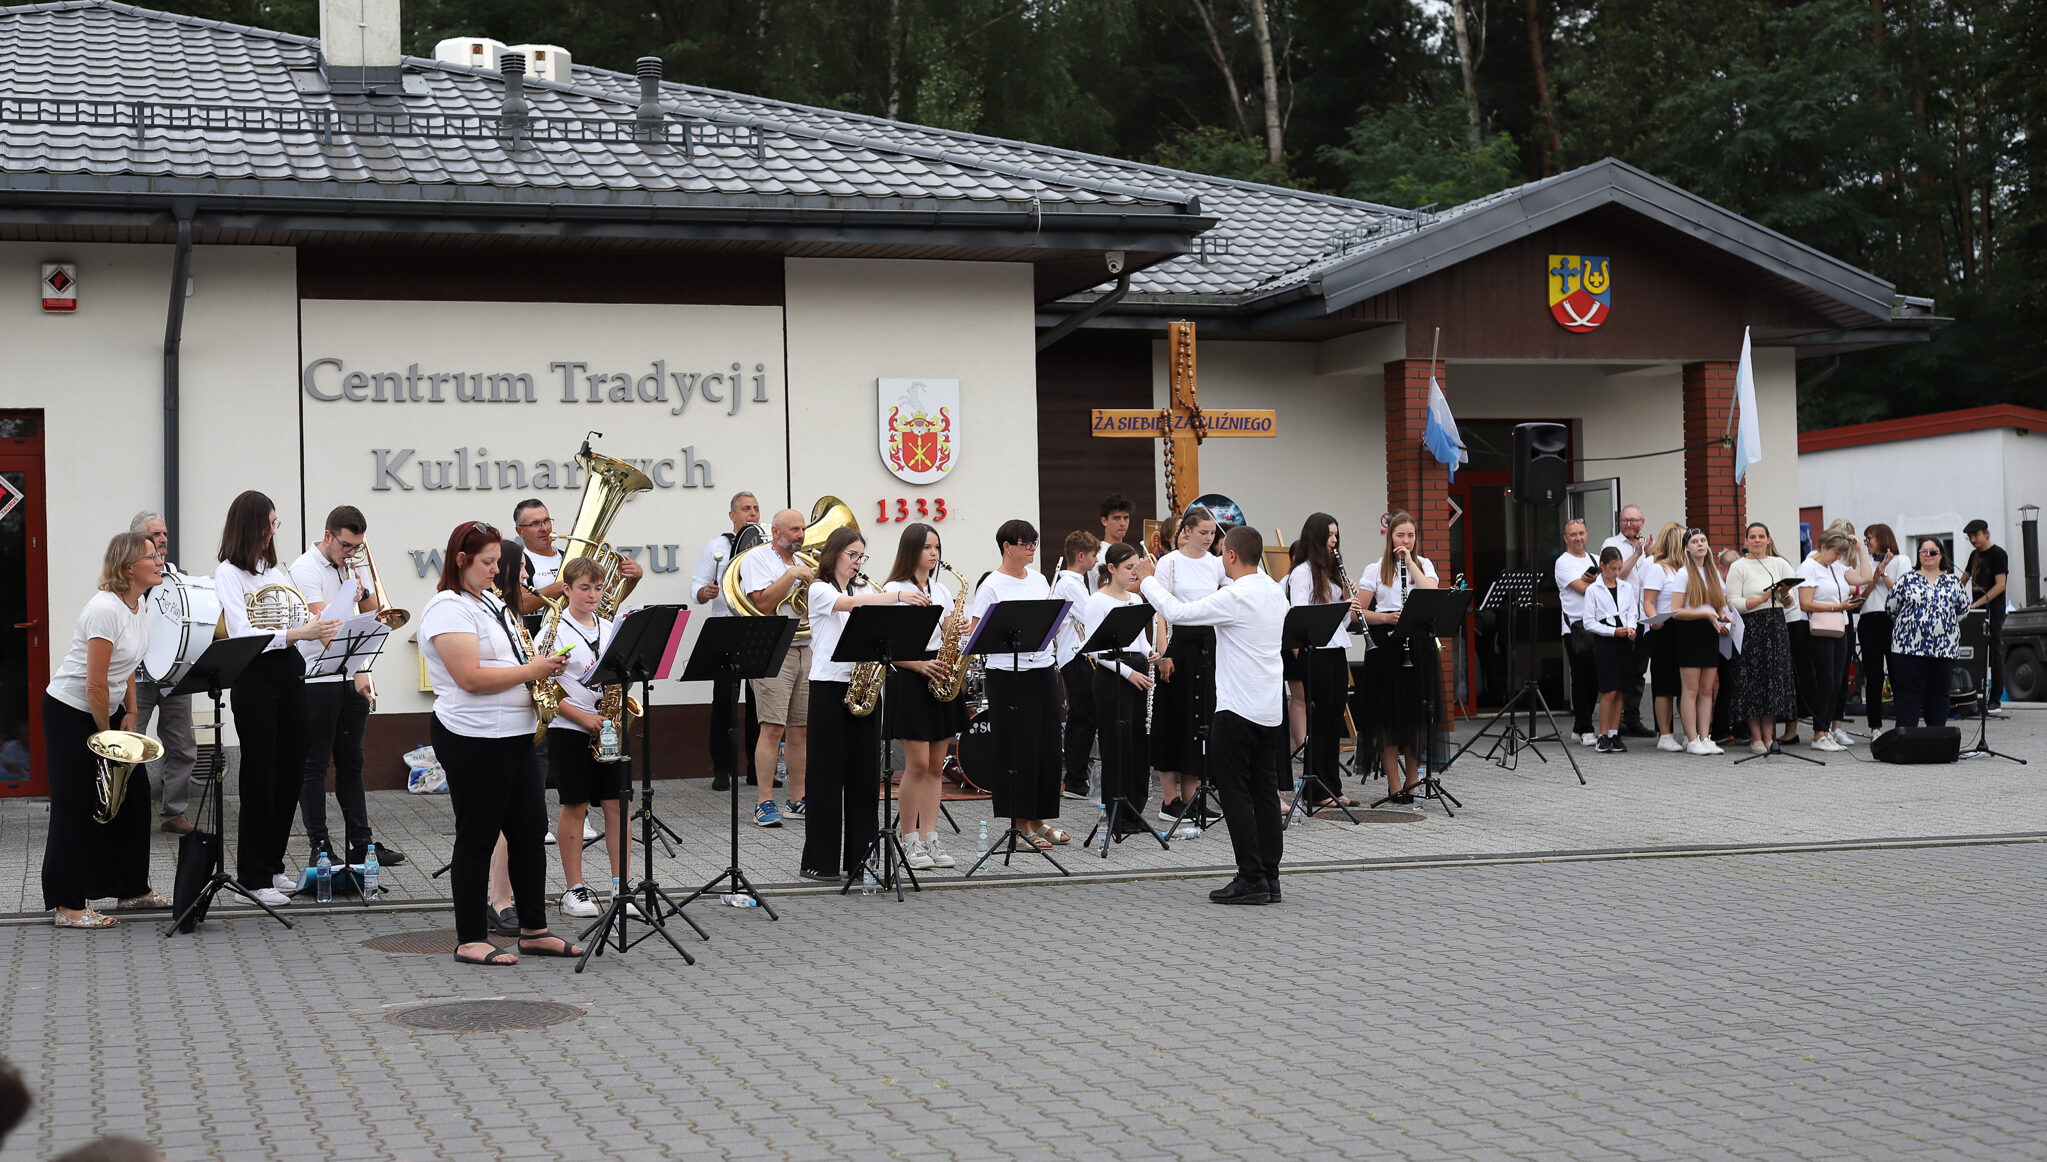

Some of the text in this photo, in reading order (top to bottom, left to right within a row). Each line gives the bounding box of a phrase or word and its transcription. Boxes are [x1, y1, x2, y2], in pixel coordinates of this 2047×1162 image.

[304, 357, 769, 416] Centrum Tradycji
[1094, 416, 1115, 430] ZA
[371, 445, 715, 502] Kulinarych
[876, 498, 947, 522] 1333
